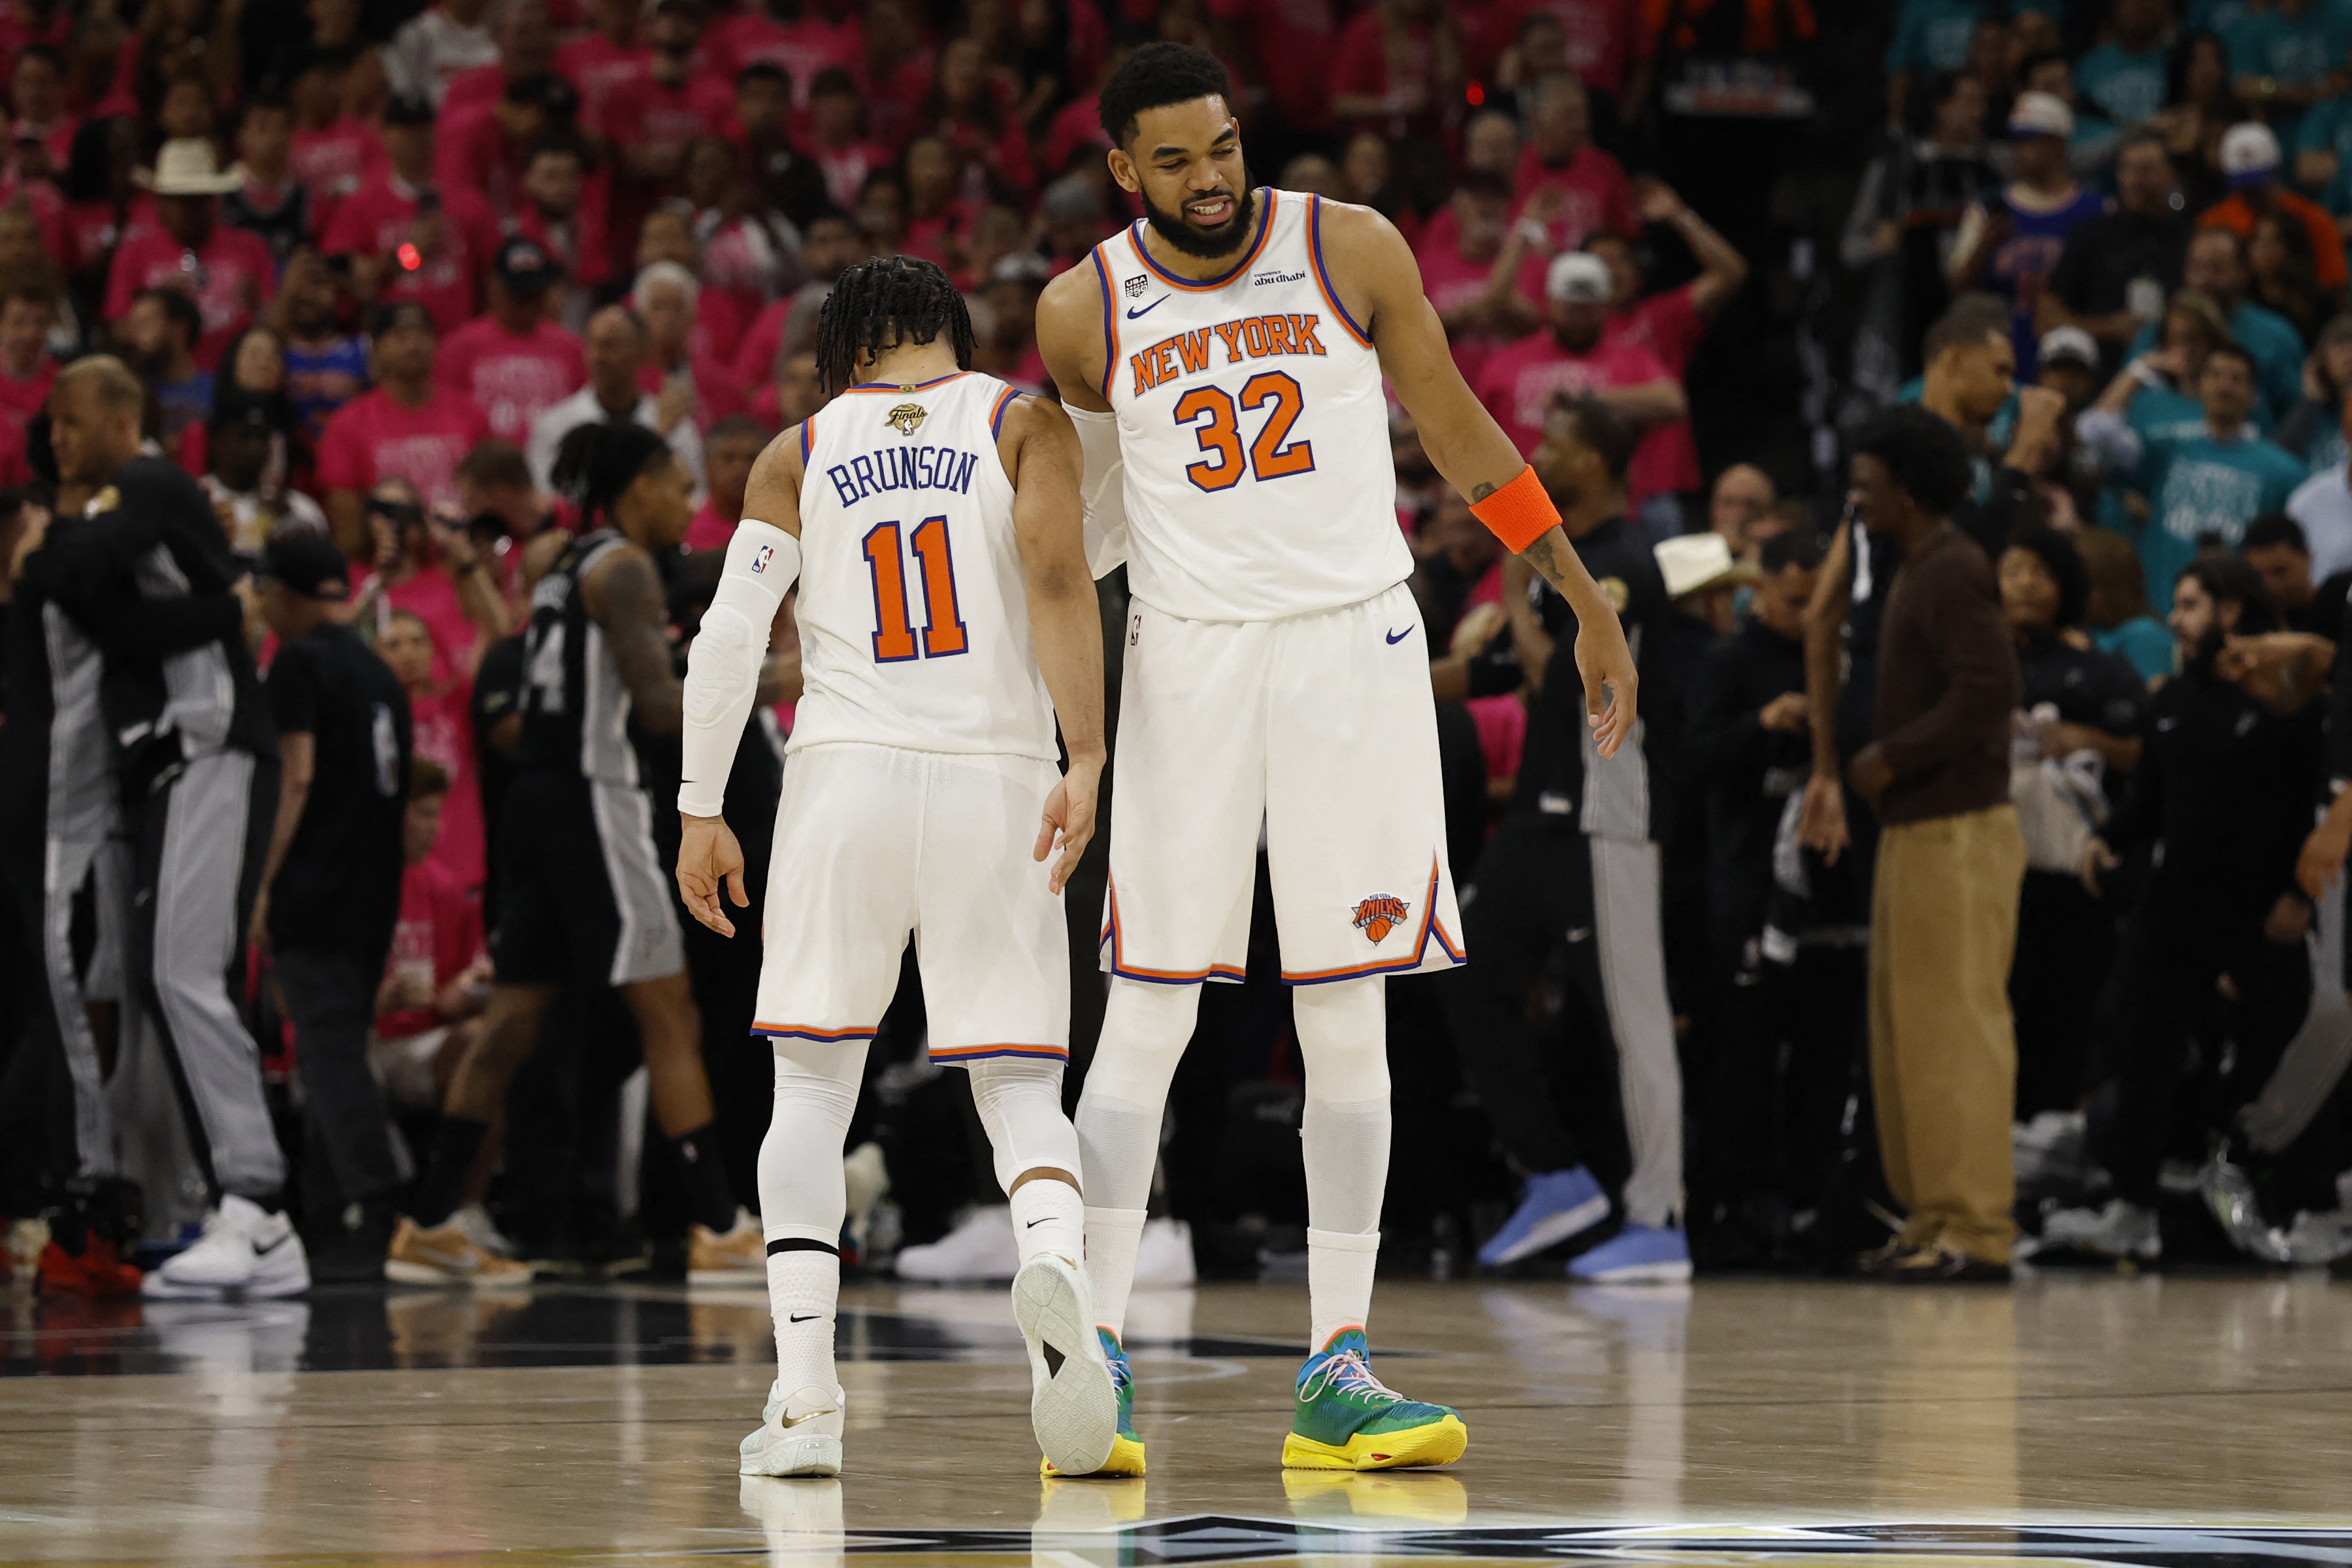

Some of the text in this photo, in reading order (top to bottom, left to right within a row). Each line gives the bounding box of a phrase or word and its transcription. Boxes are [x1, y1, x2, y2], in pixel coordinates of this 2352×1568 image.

[1126, 276, 1146, 287] USA
[1126, 285, 1148, 297] 250
[1254, 277, 1275, 286] abu
[1130, 314, 1328, 400] NEW YORK
[888, 408, 925, 425] Finals
[1173, 370, 1316, 493] 32
[826, 446, 979, 508] BRUNSON
[861, 514, 969, 664] 11
[1352, 897, 1408, 924] KNICKS
